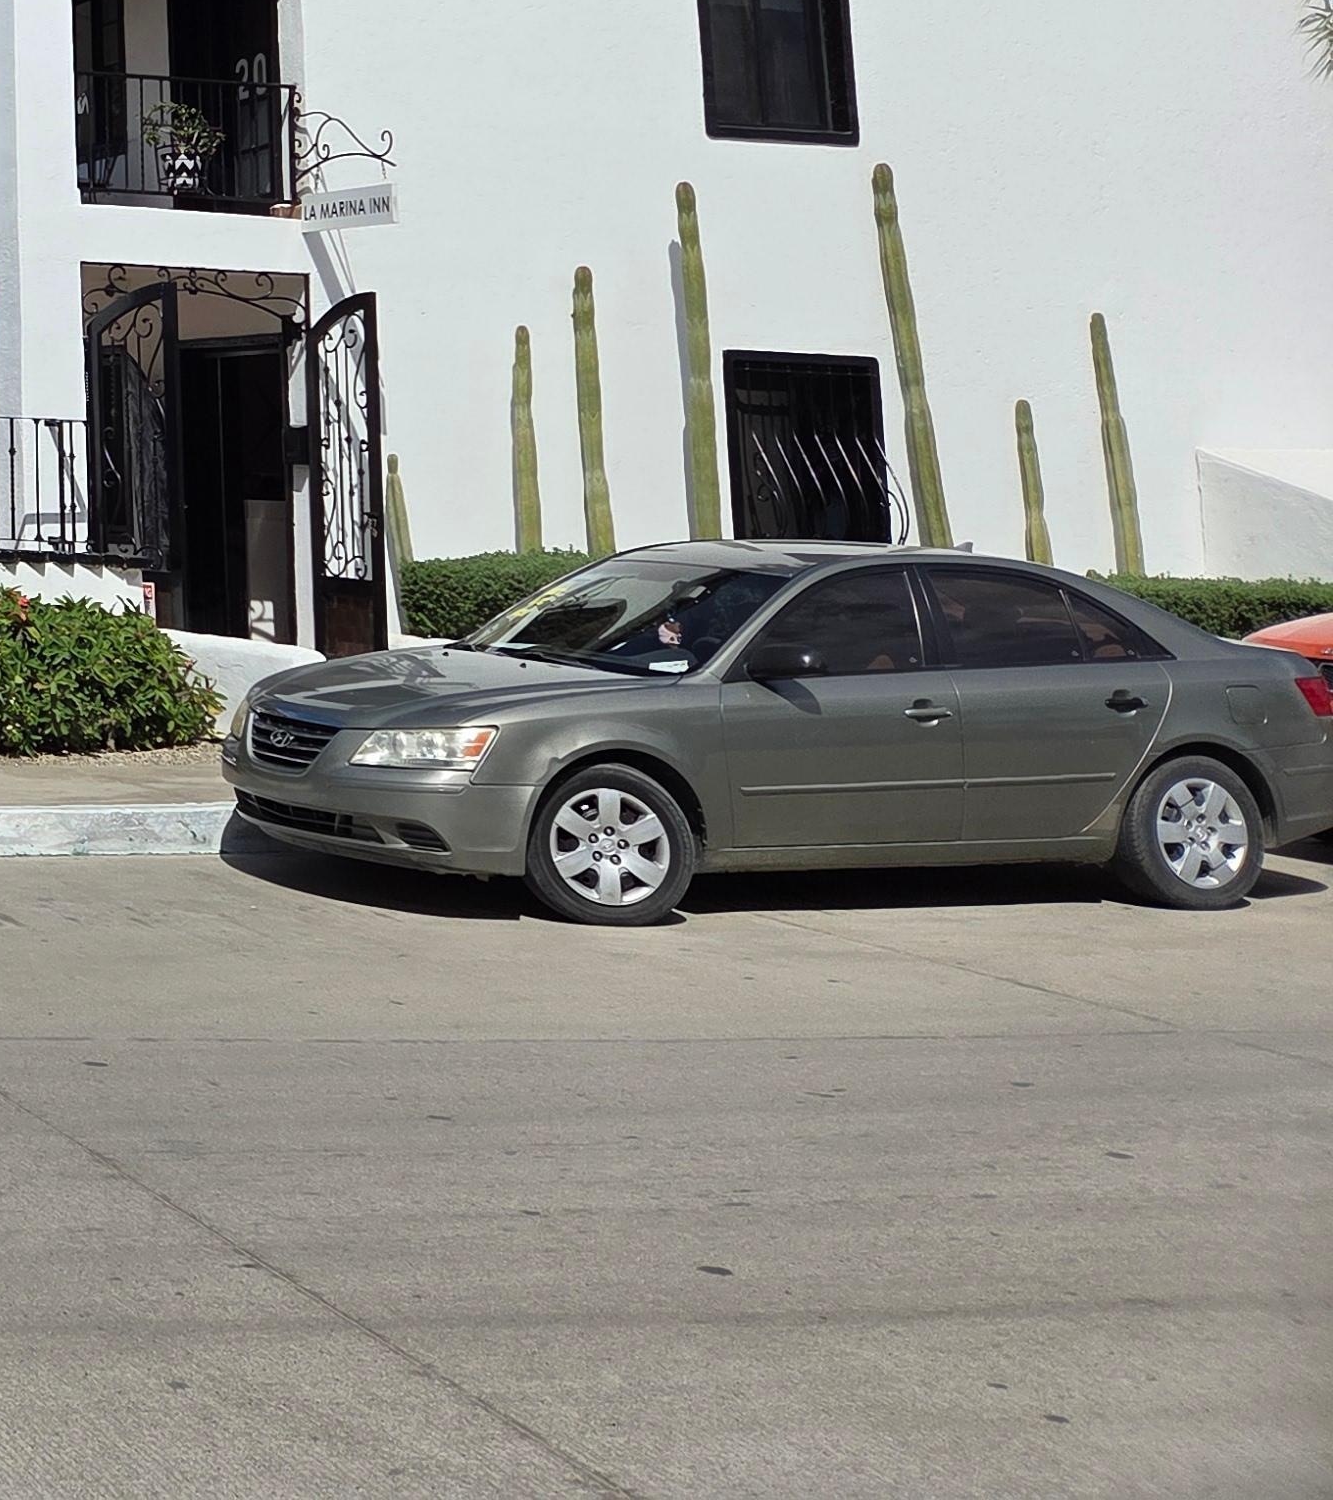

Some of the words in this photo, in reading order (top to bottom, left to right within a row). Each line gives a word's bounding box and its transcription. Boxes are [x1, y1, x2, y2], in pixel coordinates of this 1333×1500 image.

[235, 52, 267, 100] 20
[303, 203, 318, 221] LA
[320, 199, 367, 220] MARINA
[369, 196, 391, 214] INN
